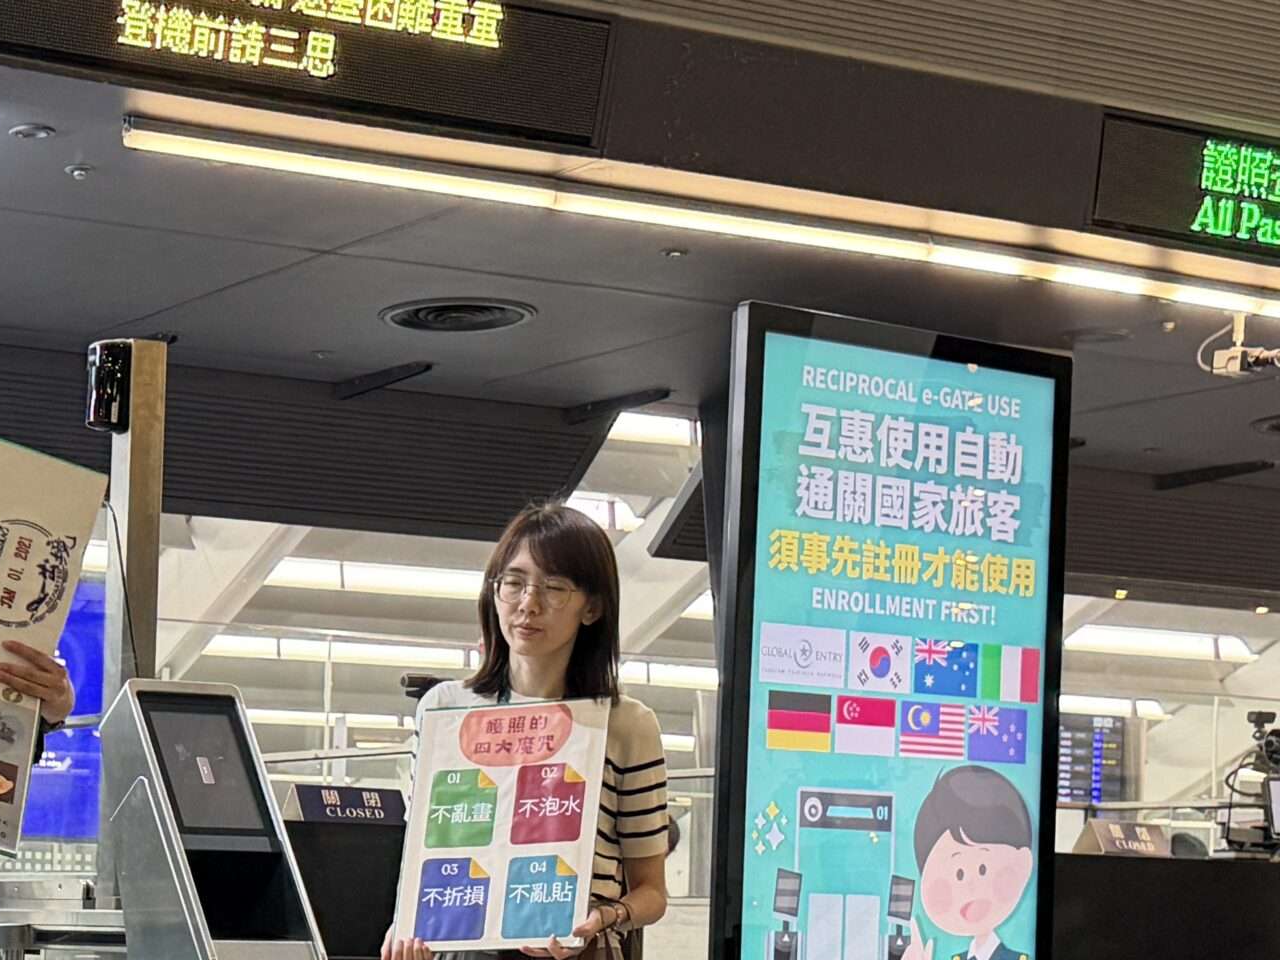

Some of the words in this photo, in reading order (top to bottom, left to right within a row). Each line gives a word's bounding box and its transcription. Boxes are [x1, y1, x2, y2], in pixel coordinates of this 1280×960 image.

[117, 0, 336, 77] 登機前請三思
[1191, 196, 1234, 236] All
[802, 365, 918, 403] RECIPROCAL
[987, 391, 1021, 418] USE
[798, 402, 1023, 484] 互惠使用自動
[796, 464, 1021, 543] 通關國家旅客
[0, 587, 17, 610] JAN
[14, 536, 33, 561] 2021
[768, 529, 1037, 598] 須事先註冊才能使用
[812, 587, 937, 618] ENROLLMENT
[940, 600, 996, 625] FIRST!
[447, 772, 461, 784] 01
[541, 767, 558, 779] 02
[326, 806, 384, 819] CLOSED
[430, 803, 493, 824] 不亂畫
[518, 796, 581, 818] 不泡水
[876, 805, 888, 821] 01
[441, 864, 458, 876] 03
[530, 862, 547, 873] 04
[422, 886, 485, 907] 不折損
[509, 882, 574, 904] 不亂貼
